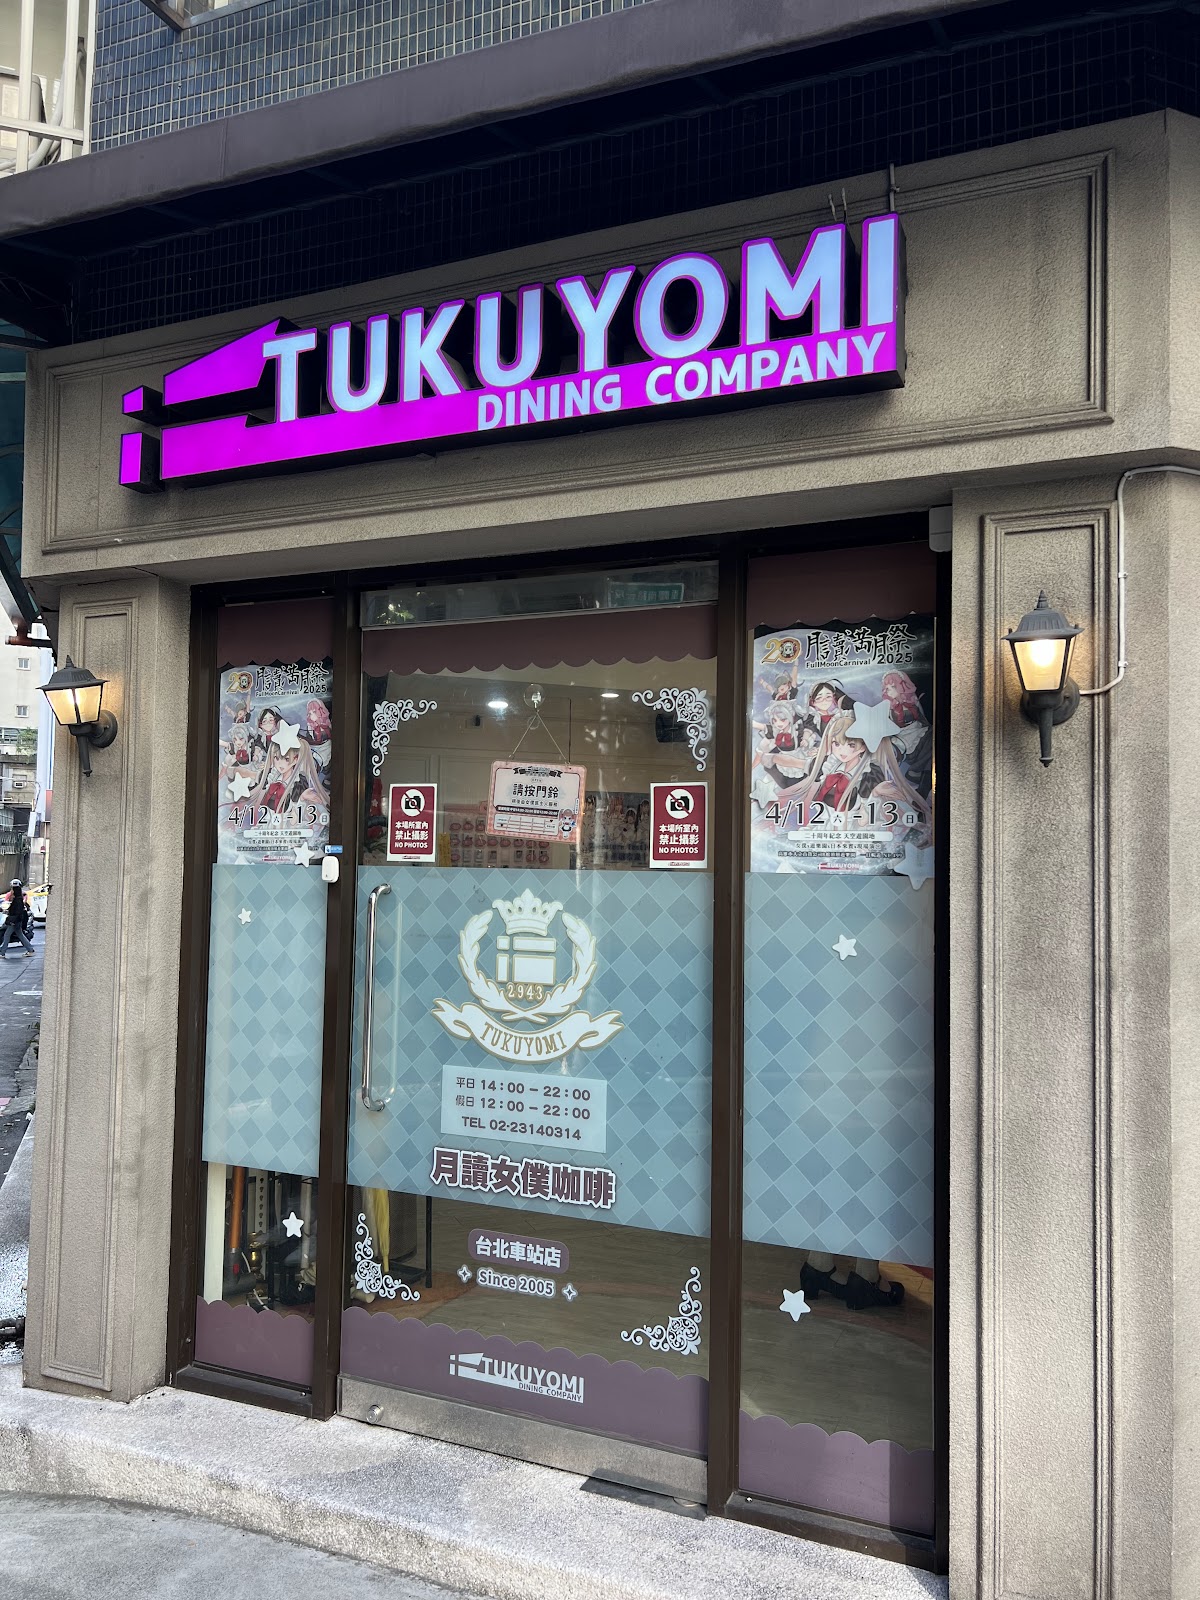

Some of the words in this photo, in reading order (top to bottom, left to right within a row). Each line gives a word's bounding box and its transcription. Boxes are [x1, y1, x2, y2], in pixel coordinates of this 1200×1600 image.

[262, 212, 899, 423] TUKUYOMI
[477, 370, 623, 432] DINING
[645, 331, 887, 405] COMPANY
[805, 658, 871, 669] FullMoonCarnival
[876, 652, 914, 665] 2025
[302, 684, 328, 694] 2025
[513, 783, 559, 799] 請按門鈴
[228, 805, 268, 828] 4/12
[765, 801, 826, 828] 4/12
[906, 814, 914, 824] 日
[395, 820, 429, 830] 本場所室內
[659, 823, 699, 833] 本場所室內
[395, 830, 429, 841] 禁止攝影
[659, 833, 700, 845] 禁止攝影
[404, 841, 428, 849] PHOTOS
[658, 846, 669, 854] NO
[670, 846, 699, 854] PHOTOS
[507, 983, 544, 1000] 2943
[479, 1021, 567, 1057] TUKUYOMI
[456, 1077, 475, 1089] 平日
[455, 1095, 475, 1107] 假日
[461, 1116, 486, 1129] TEL
[430, 1147, 617, 1209] 月讀女僕咖啡
[475, 1235, 562, 1268] 台北車站店
[478, 1270, 517, 1289] Since
[519, 1276, 554, 1296] 2005
[482, 1356, 585, 1398] TUKUYOMI
[518, 1382, 544, 1394] DINING
[546, 1388, 582, 1402] COMPANY
